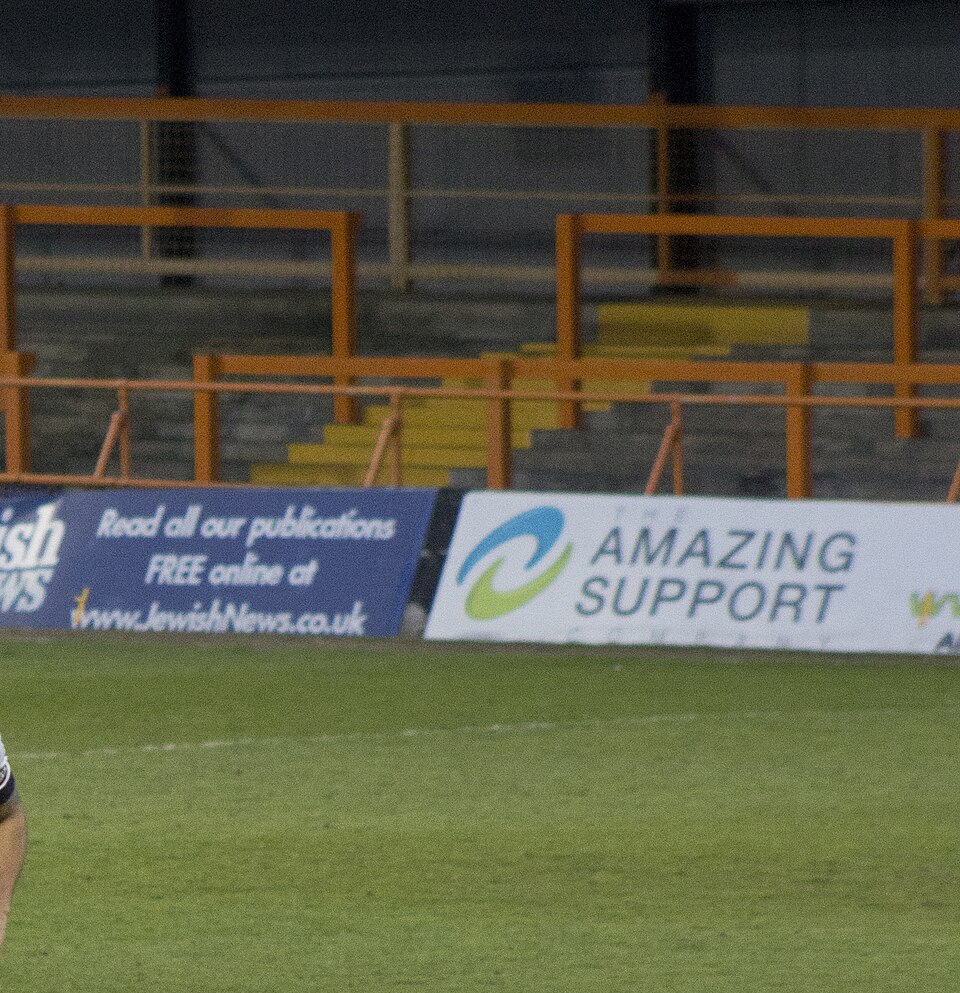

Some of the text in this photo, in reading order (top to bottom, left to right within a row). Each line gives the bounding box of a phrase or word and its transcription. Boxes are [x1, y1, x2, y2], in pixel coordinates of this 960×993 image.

[96, 506, 396, 546] Read all our publications
[145, 552, 318, 586] FREE online at
[589, 526, 858, 574] AMAZING
[71, 598, 367, 636] www.JewishNews.co.uk
[574, 575, 847, 624] SUPPORT
